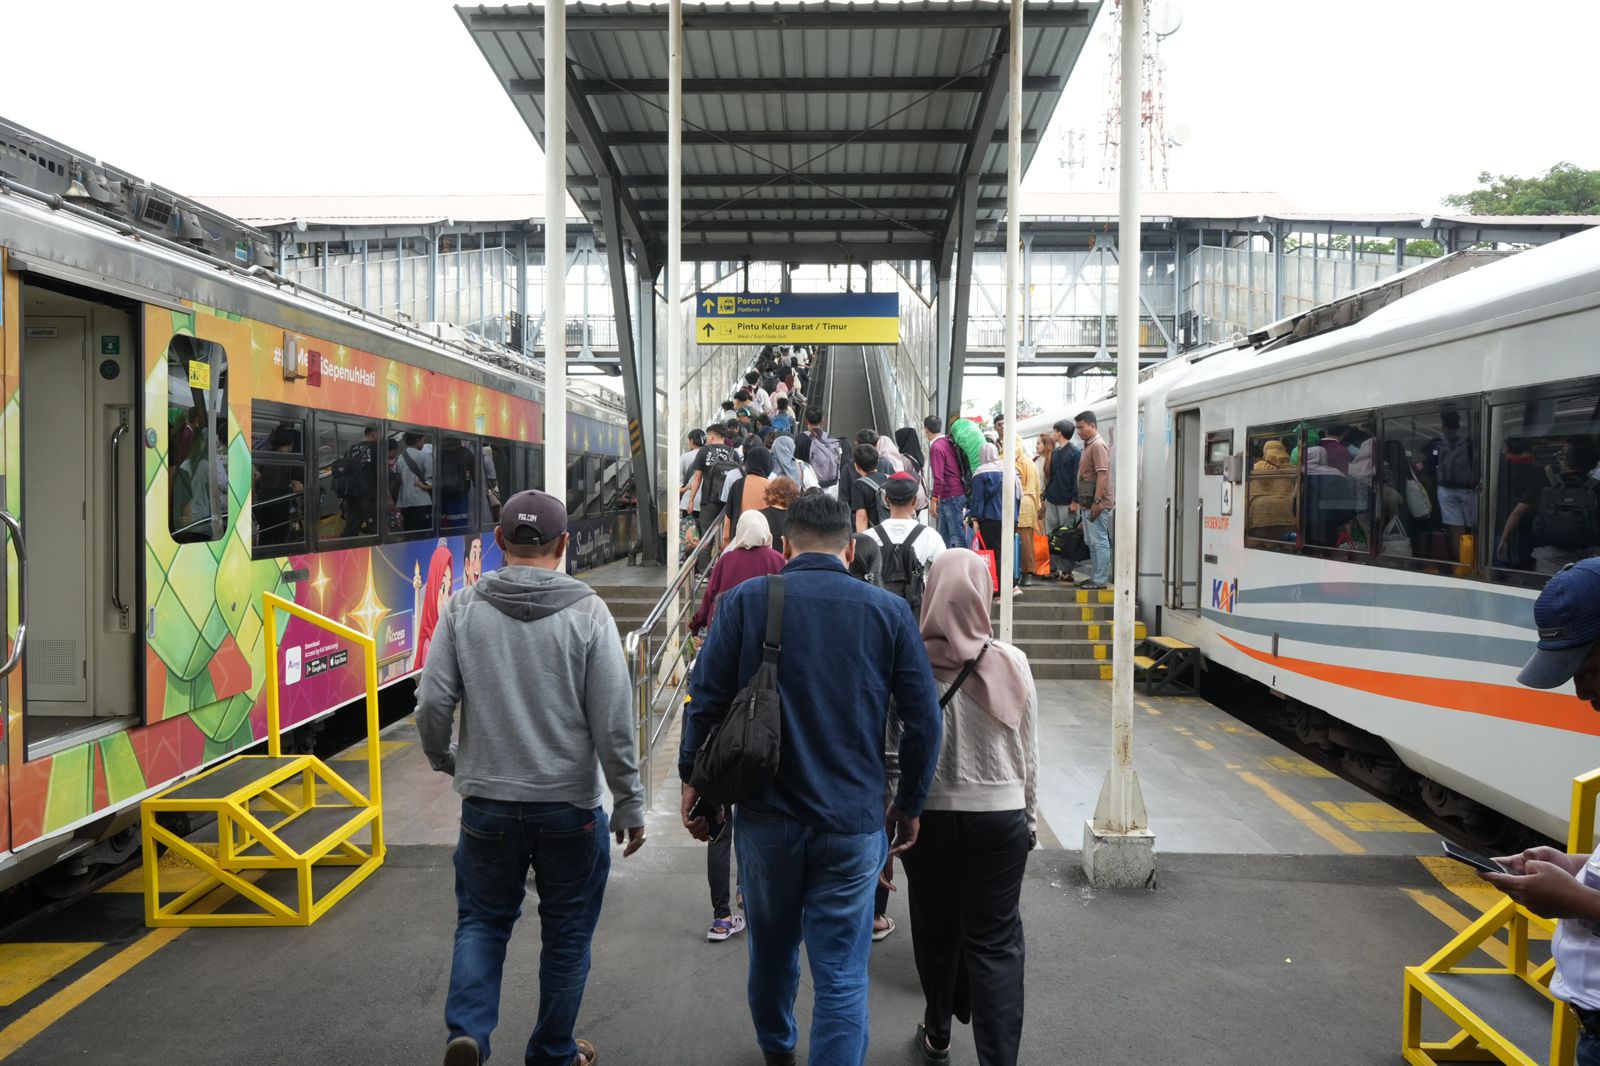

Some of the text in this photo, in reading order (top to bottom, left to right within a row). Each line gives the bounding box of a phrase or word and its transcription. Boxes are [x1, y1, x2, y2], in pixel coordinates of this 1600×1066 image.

[737, 297, 761, 305] Peron
[1223, 488, 1230, 507] 4
[1212, 578, 1237, 613] KAI
